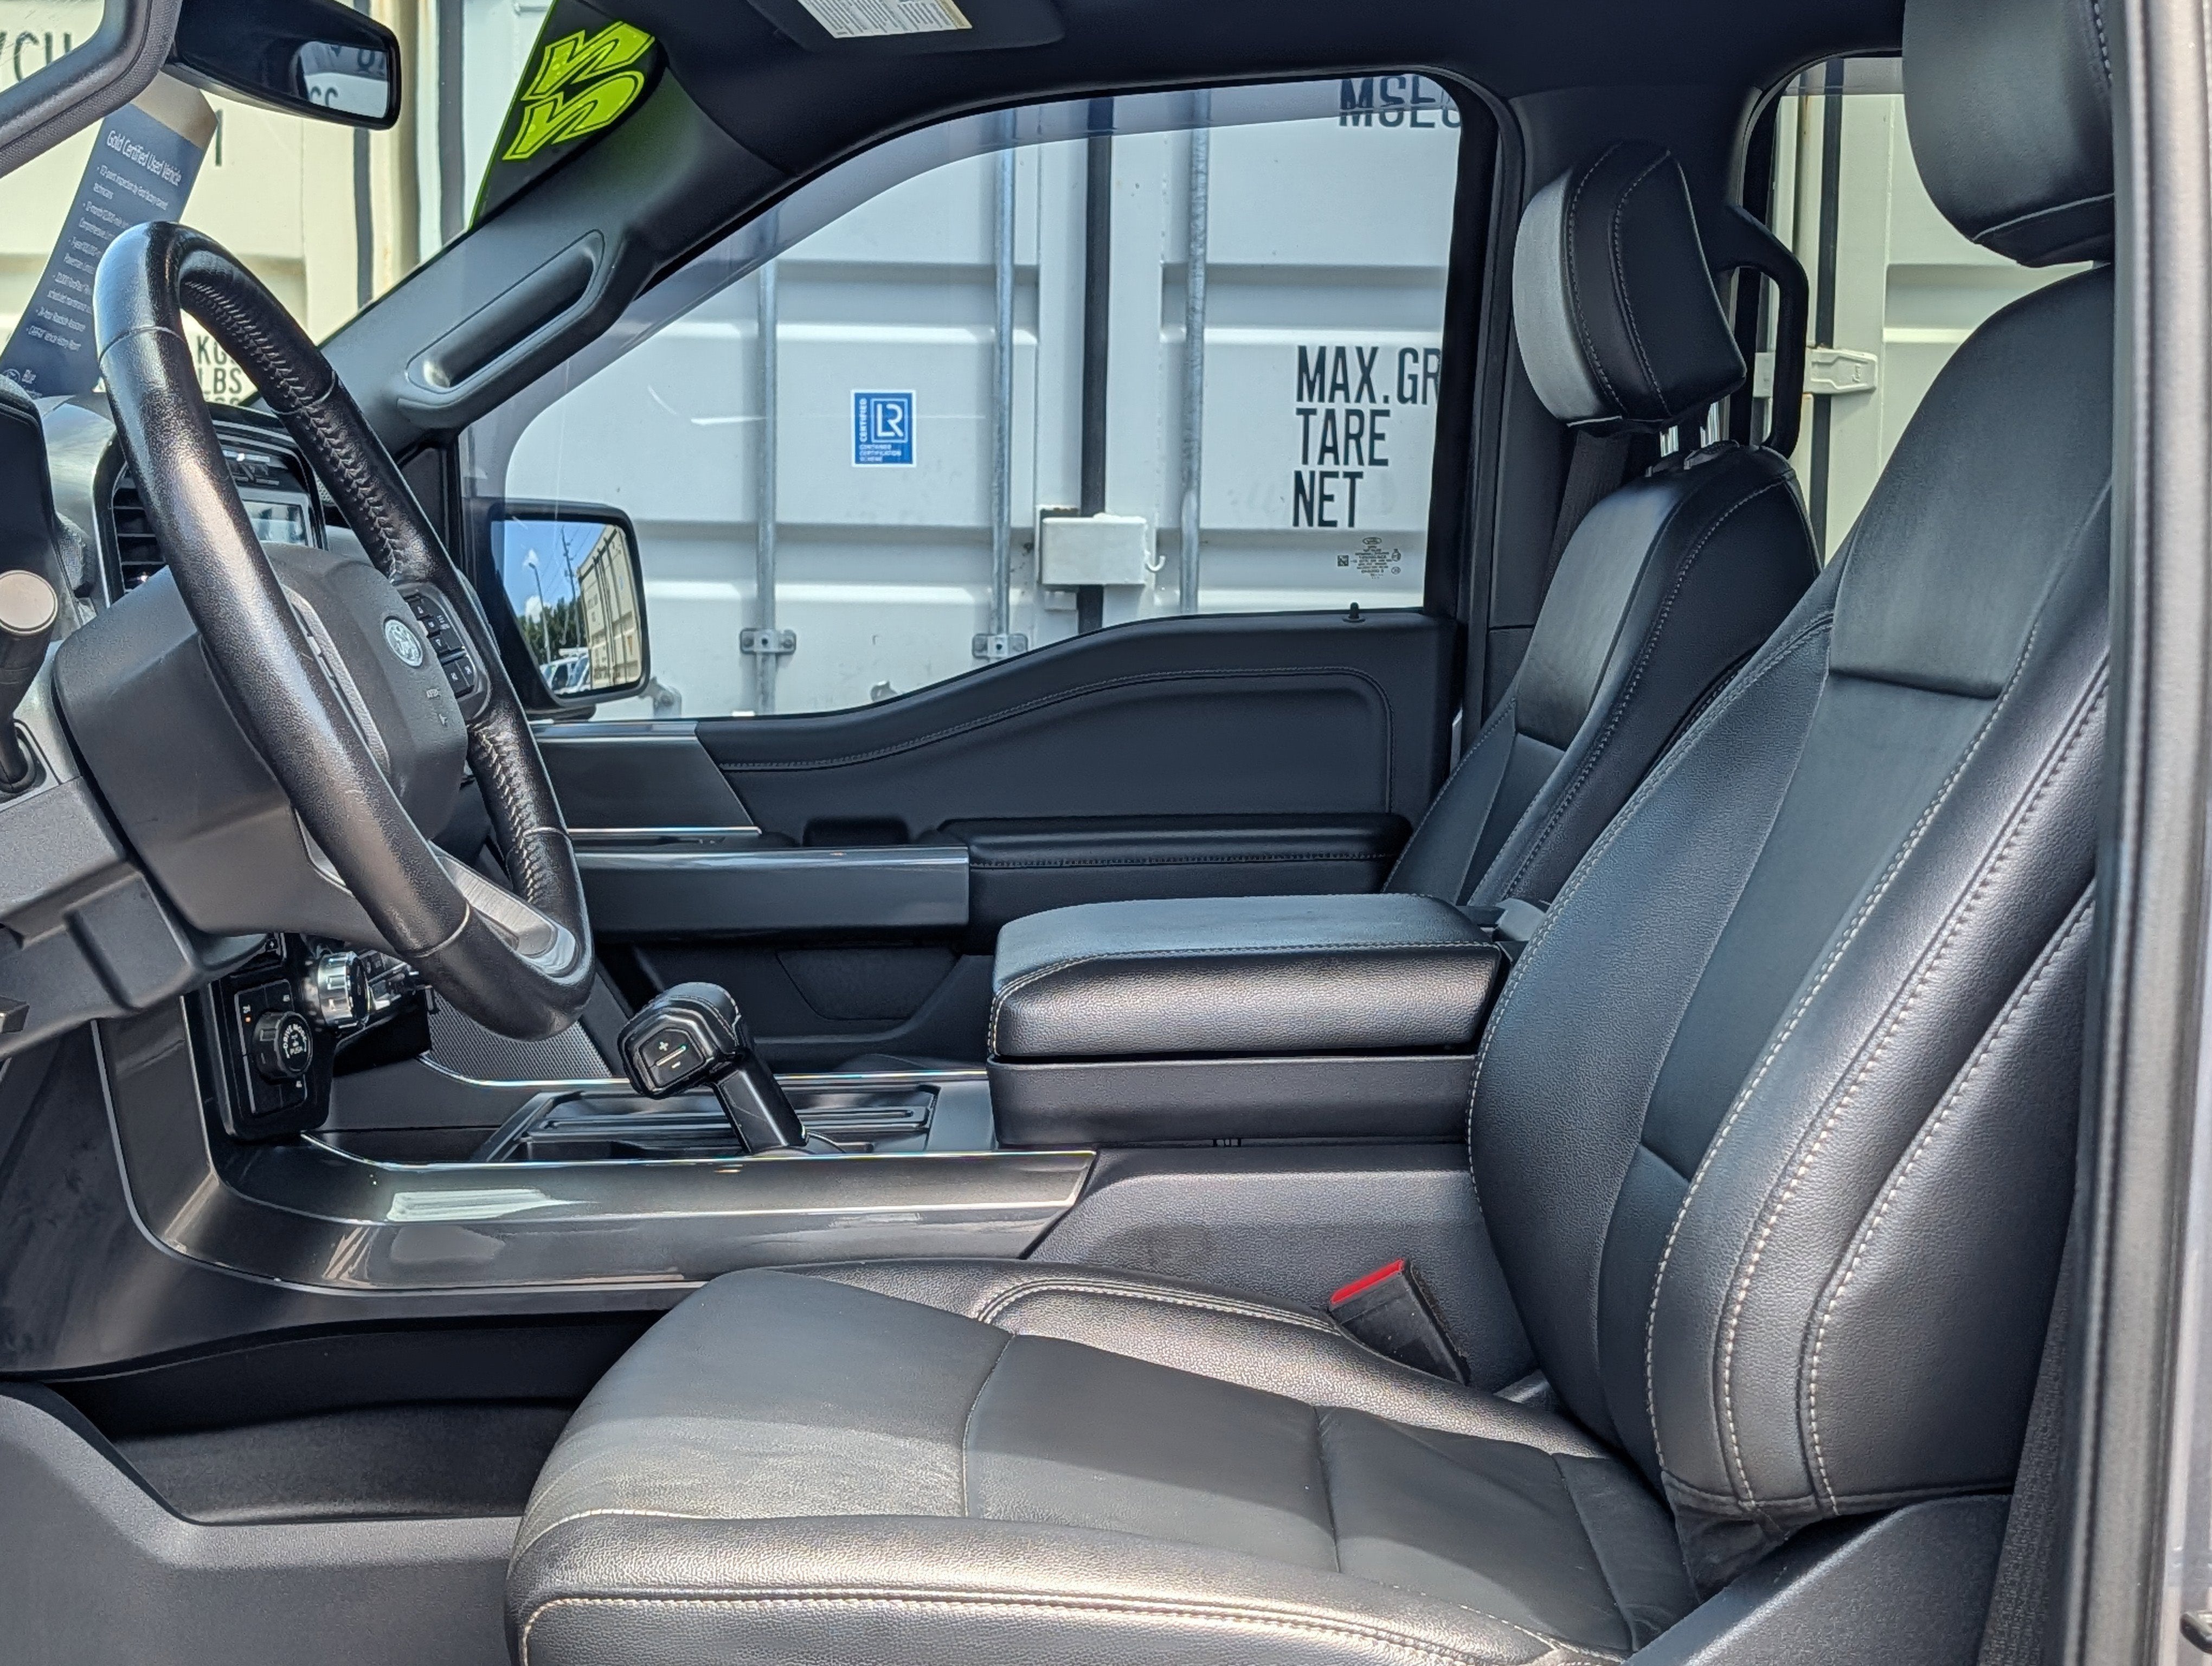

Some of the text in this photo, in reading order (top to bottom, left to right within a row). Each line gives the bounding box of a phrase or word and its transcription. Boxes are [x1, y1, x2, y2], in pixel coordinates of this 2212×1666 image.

[107, 130, 125, 151] Gold
[122, 139, 150, 166] Certified
[147, 152, 165, 175] Used
[162, 161, 182, 187] Vehicle
[197, 335, 236, 366] KG
[876, 403, 904, 437] LR
[1295, 407, 1391, 467] TARE
[1292, 470, 1364, 528] NET
